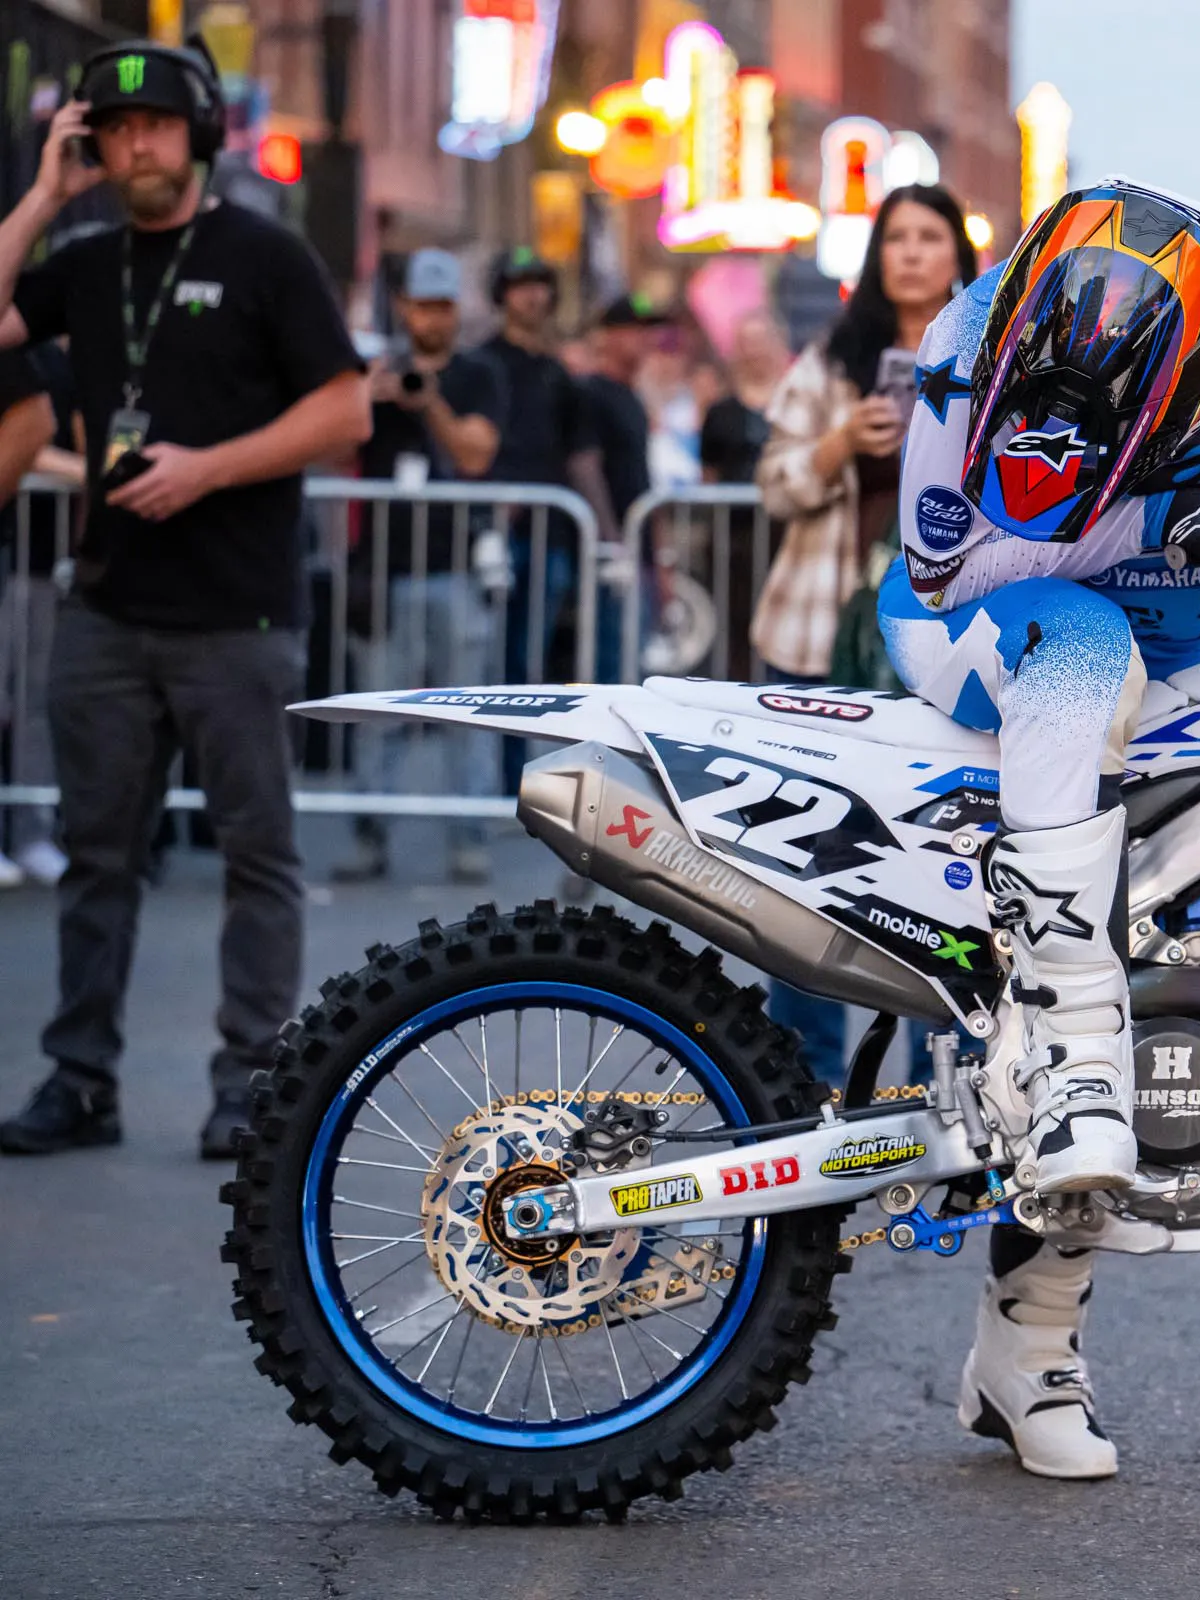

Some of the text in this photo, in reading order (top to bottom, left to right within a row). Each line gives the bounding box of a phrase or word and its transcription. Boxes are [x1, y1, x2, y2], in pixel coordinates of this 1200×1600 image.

[921, 497, 966, 513] BLU
[922, 506, 968, 522] CRU
[928, 526, 959, 540] YAMAHA
[421, 694, 557, 707] DUNLOP
[762, 695, 869, 718] GUTS
[789, 746, 837, 761] REED
[977, 774, 1000, 785] MOT
[980, 798, 995, 806] NO
[683, 757, 852, 870] 22
[868, 907, 980, 970] mobileX
[1152, 1046, 1192, 1079] H
[828, 1133, 915, 1161] MOUNTAIN
[820, 1146, 926, 1174] MOTORSPORTS
[719, 1156, 801, 1196] D.I.D
